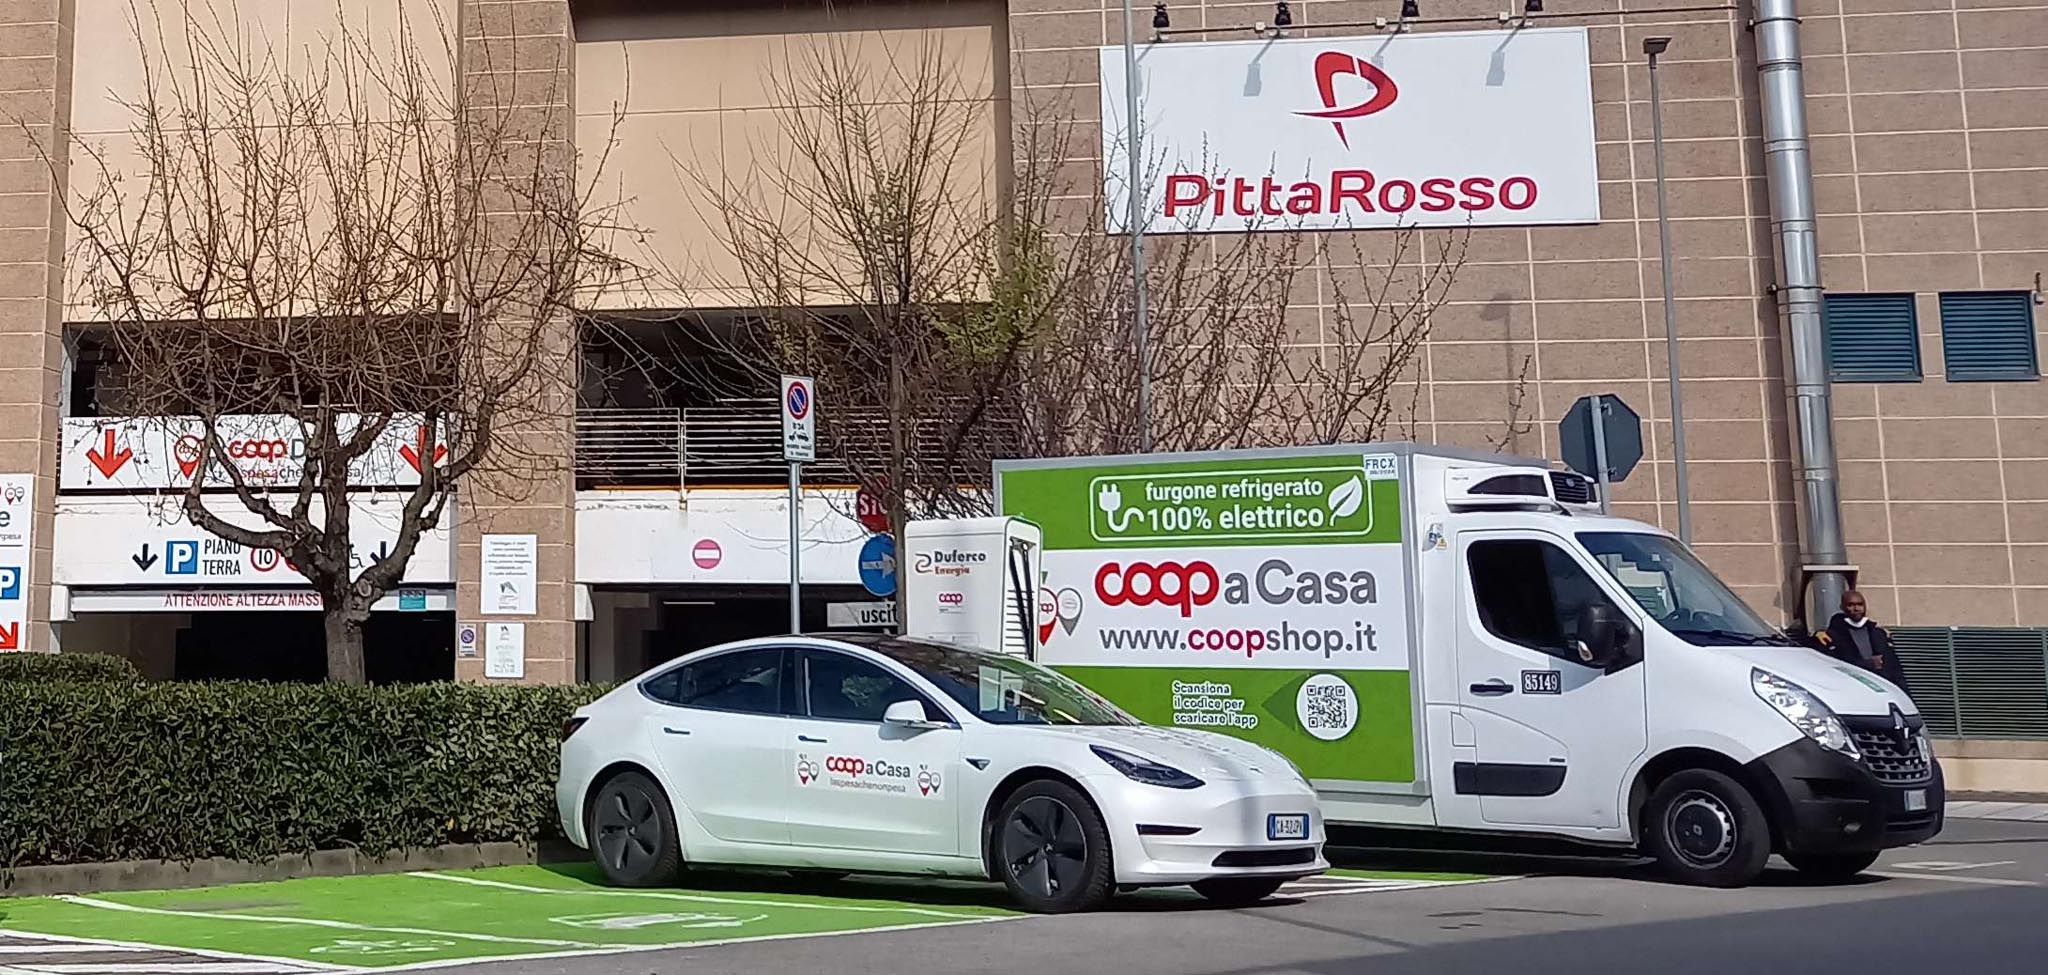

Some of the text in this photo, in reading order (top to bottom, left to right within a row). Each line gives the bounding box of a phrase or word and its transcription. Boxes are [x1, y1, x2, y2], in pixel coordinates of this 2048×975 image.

[1164, 169, 1538, 218] PittaRosso
[228, 439, 287, 462] coop
[1365, 458, 1395, 470] FRCX
[1145, 478, 1323, 505] furgone refrigerato
[1147, 503, 1324, 531] 100% elettrico
[204, 539, 241, 555] PIANO
[258, 550, 273, 565] 10
[934, 550, 987, 562] Duferco
[203, 559, 241, 575] TERRA
[935, 565, 970, 576] Energia
[1095, 559, 1377, 617] coop a Casa
[165, 592, 233, 607] ATTENZIONE
[236, 592, 285, 606] ALTEZZA
[939, 593, 963, 605] coop
[861, 604, 898, 623] uscit
[1100, 621, 1378, 658] www.coopshop.it
[1173, 681, 1231, 695] Scansiona
[1525, 674, 1558, 690] 85149
[1174, 696, 1244, 712] il codice per
[1174, 712, 1257, 728] scaricare l'app
[826, 756, 911, 778] coop a Casa
